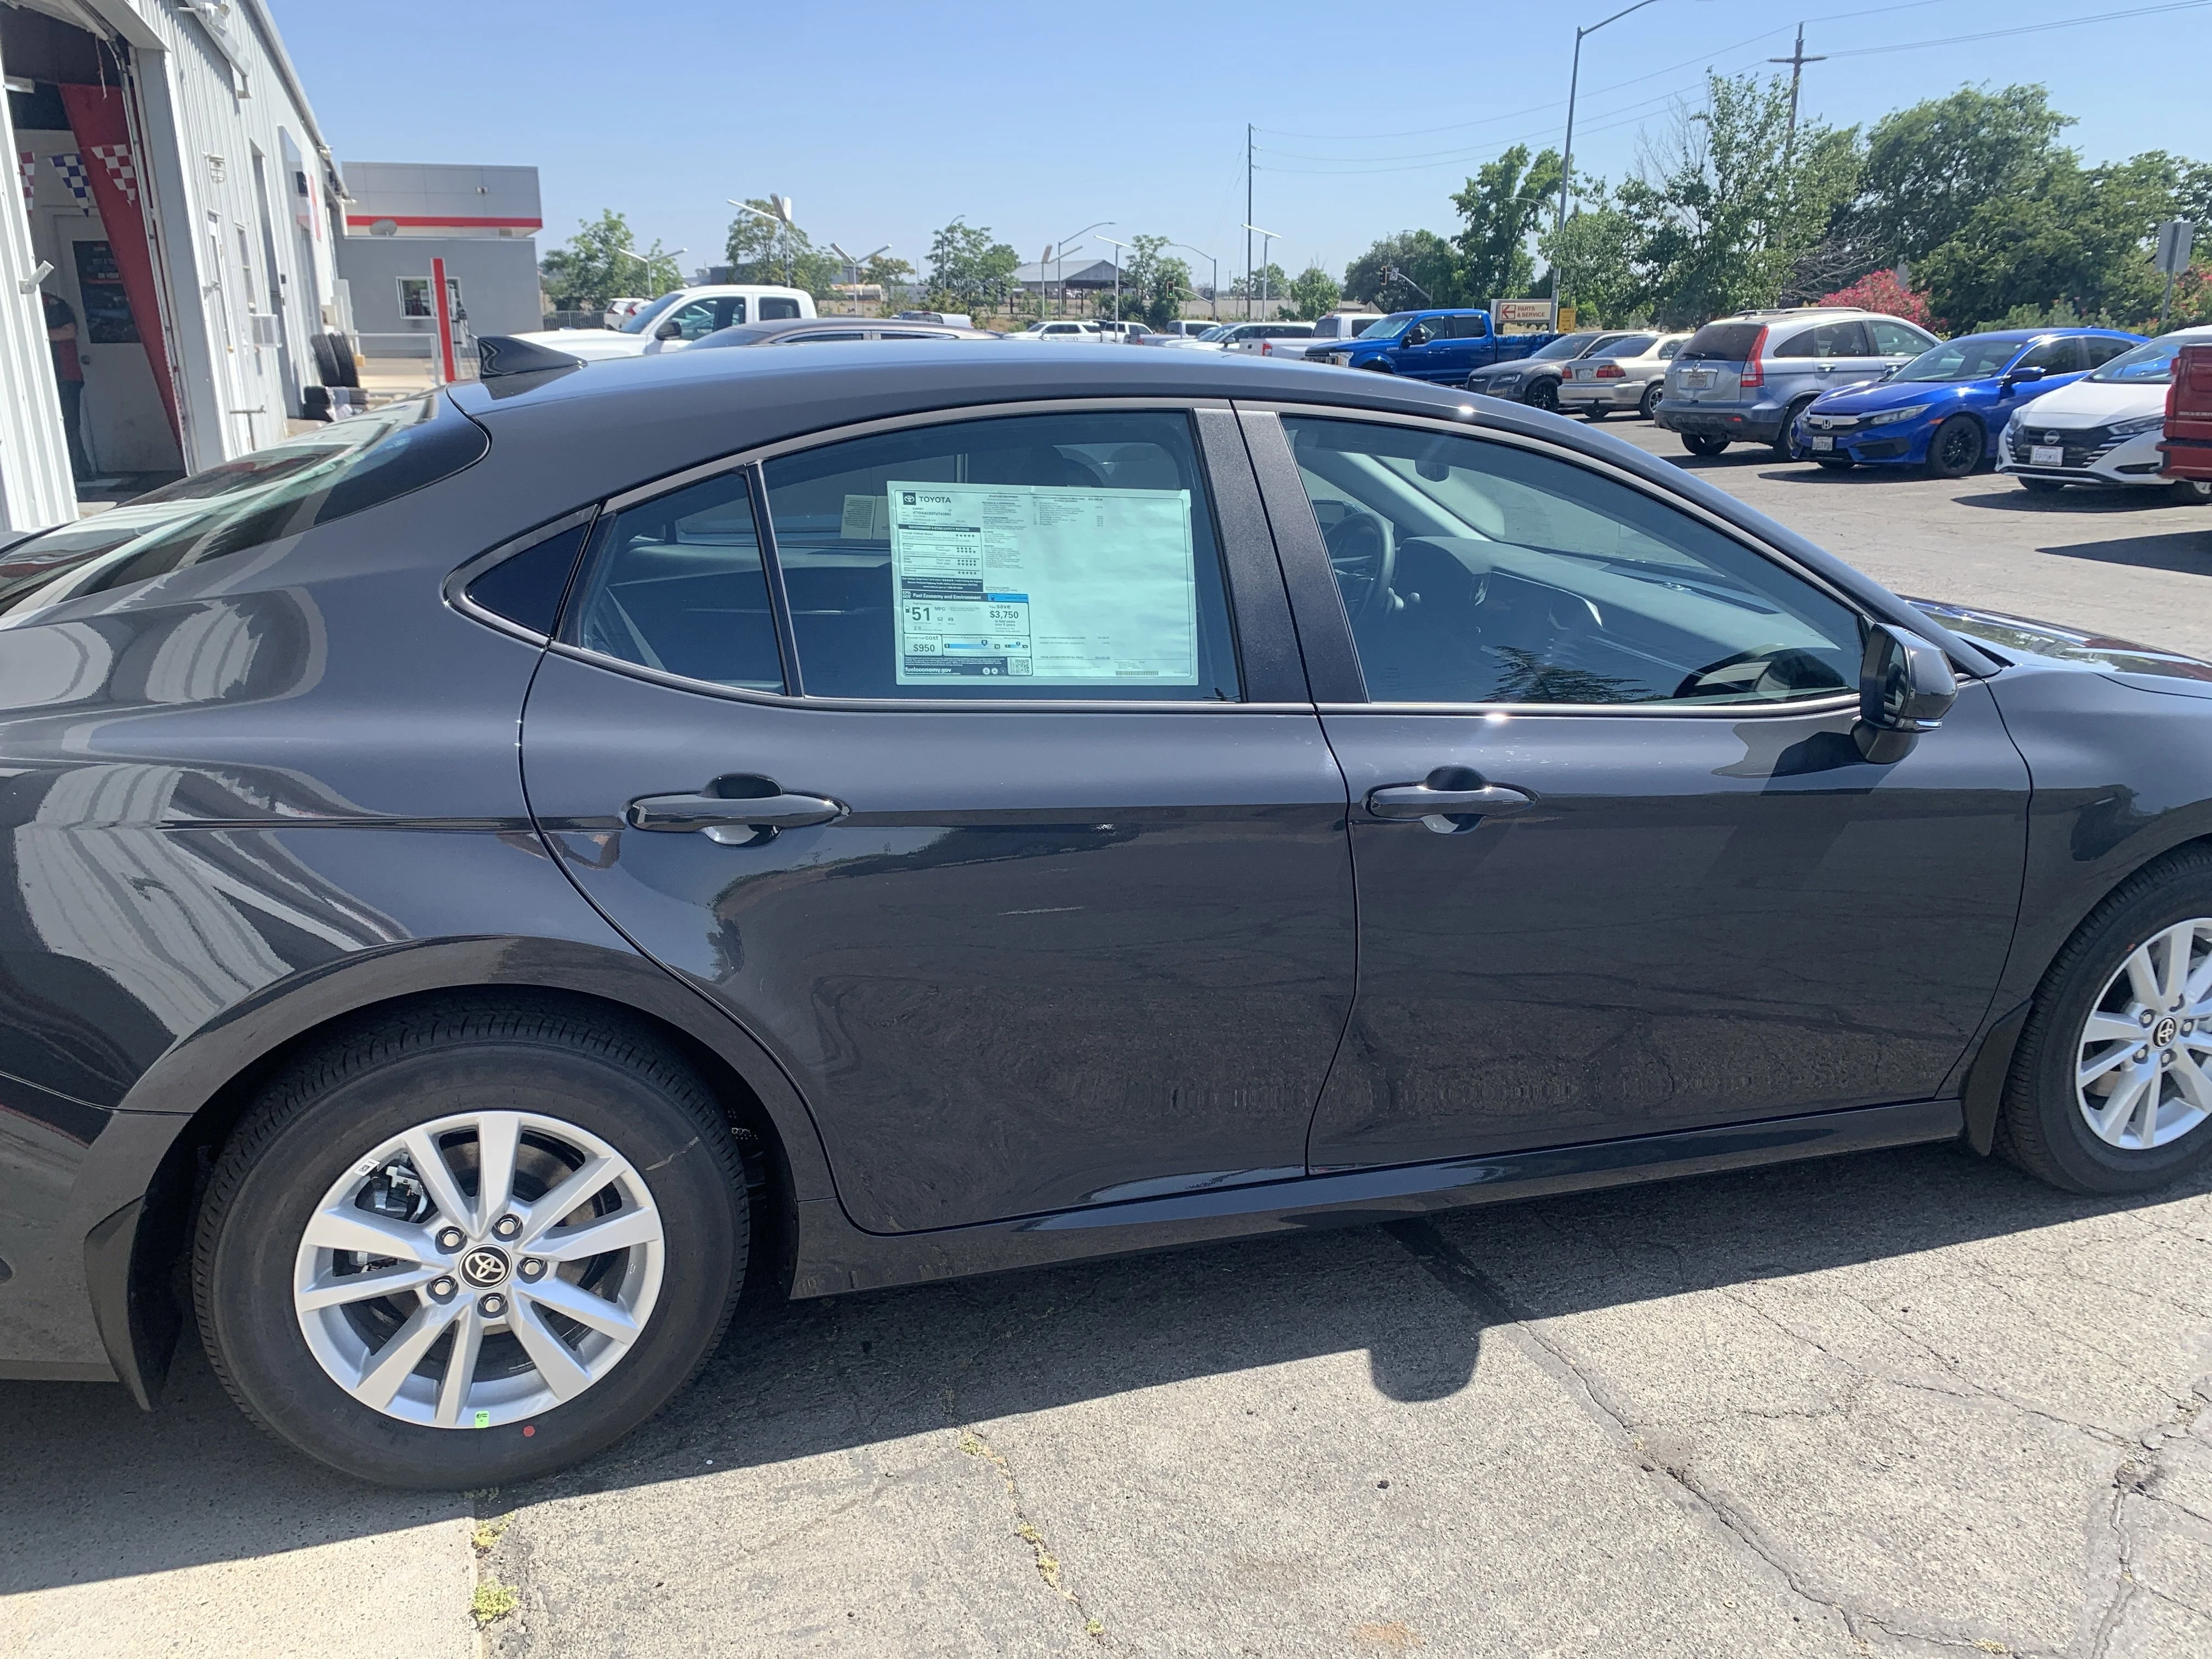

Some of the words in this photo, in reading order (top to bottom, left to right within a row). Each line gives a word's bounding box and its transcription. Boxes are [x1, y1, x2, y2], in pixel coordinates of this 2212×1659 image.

[912, 607, 930, 621] 51
[990, 610, 1019, 619] $3,750
[913, 644, 935, 652] $950
